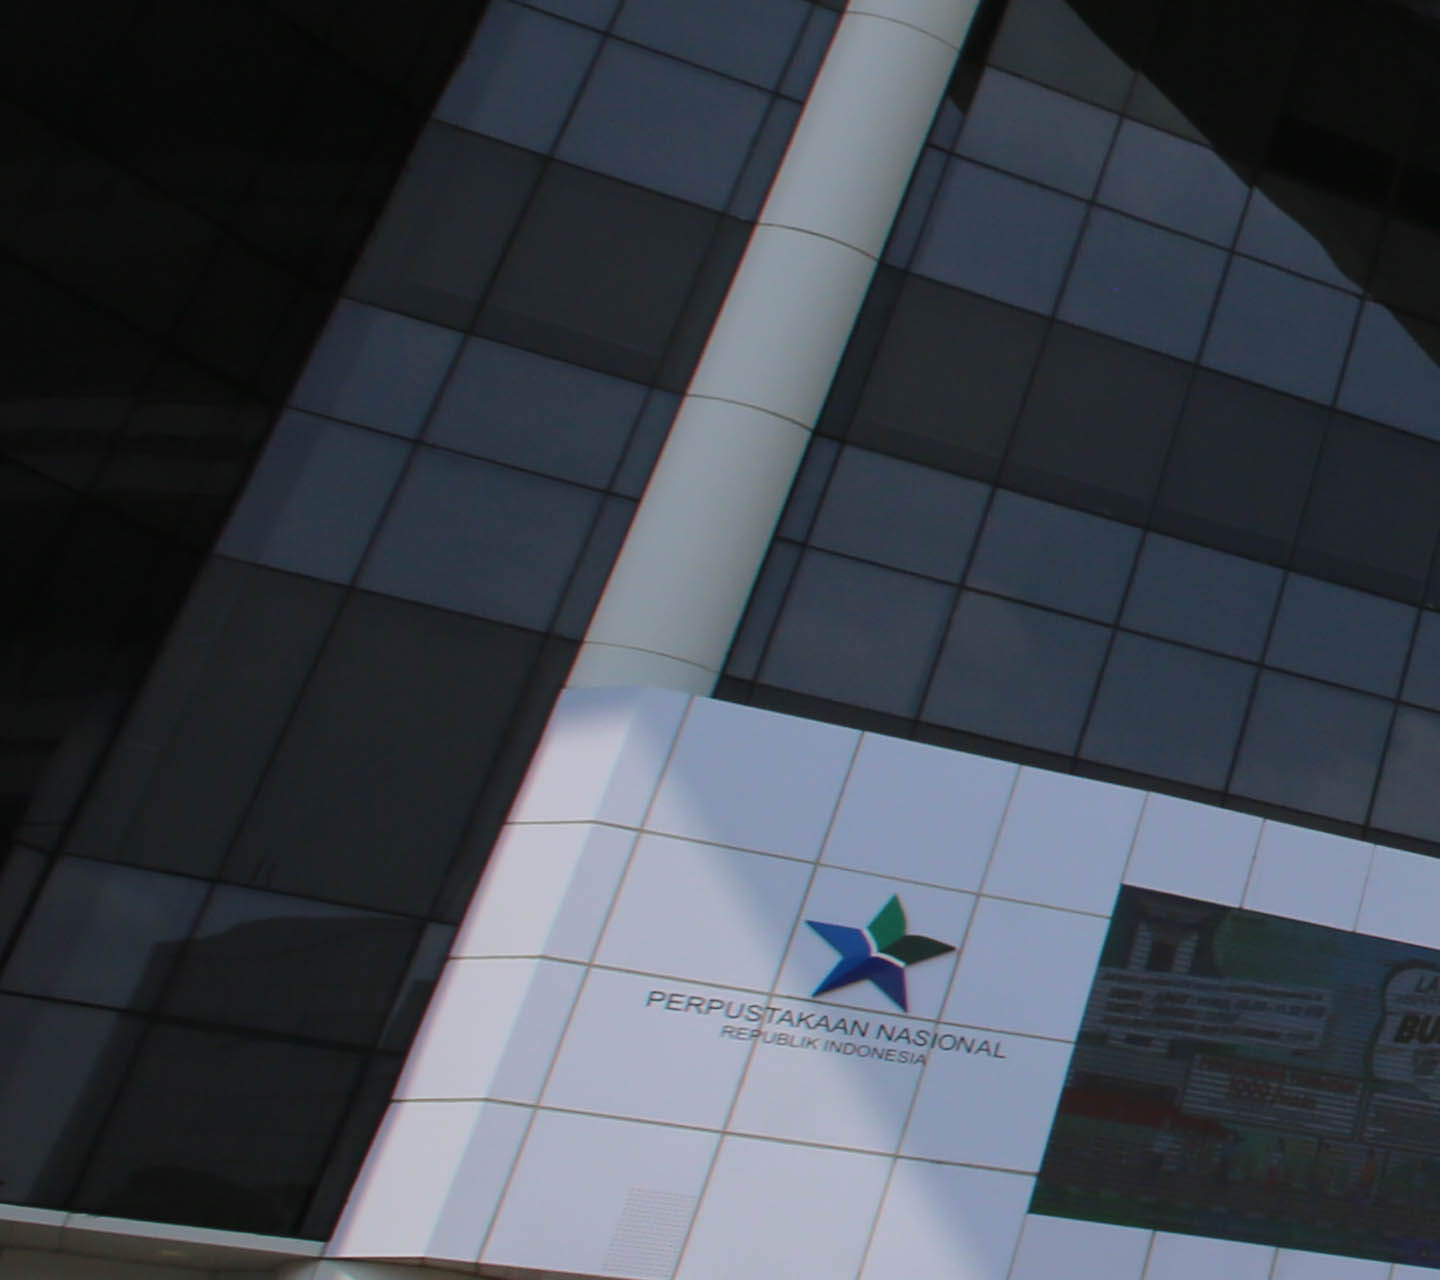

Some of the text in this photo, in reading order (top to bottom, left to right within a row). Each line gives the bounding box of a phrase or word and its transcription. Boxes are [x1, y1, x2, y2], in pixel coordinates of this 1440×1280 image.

[645, 989, 1008, 1060] PERPUSTAKAAN NASIONAL
[719, 1024, 927, 1067] REPUBLIK INDONESIA
